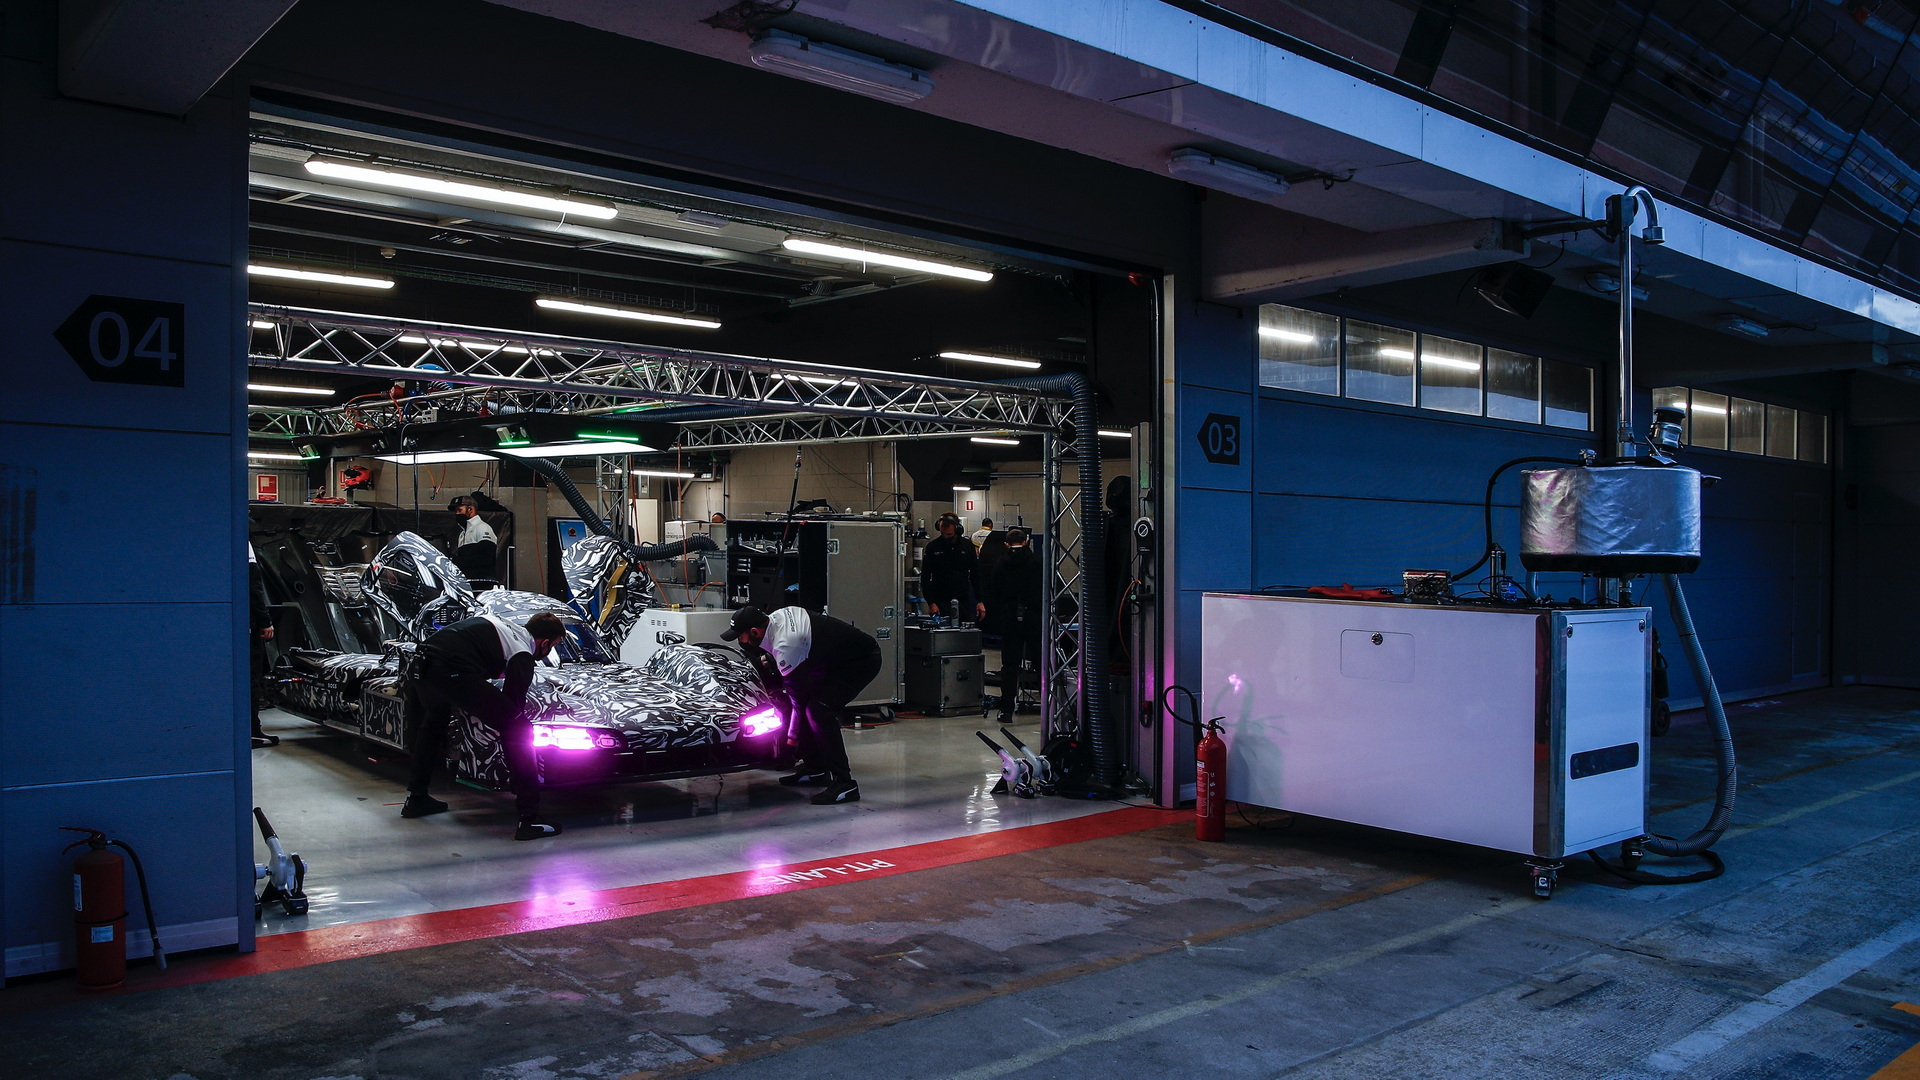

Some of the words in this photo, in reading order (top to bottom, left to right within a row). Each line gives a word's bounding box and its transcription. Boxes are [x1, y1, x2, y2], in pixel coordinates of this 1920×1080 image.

[89, 311, 177, 371] 04
[1208, 422, 1237, 456] 03
[757, 858, 897, 886] PIT-LANE
